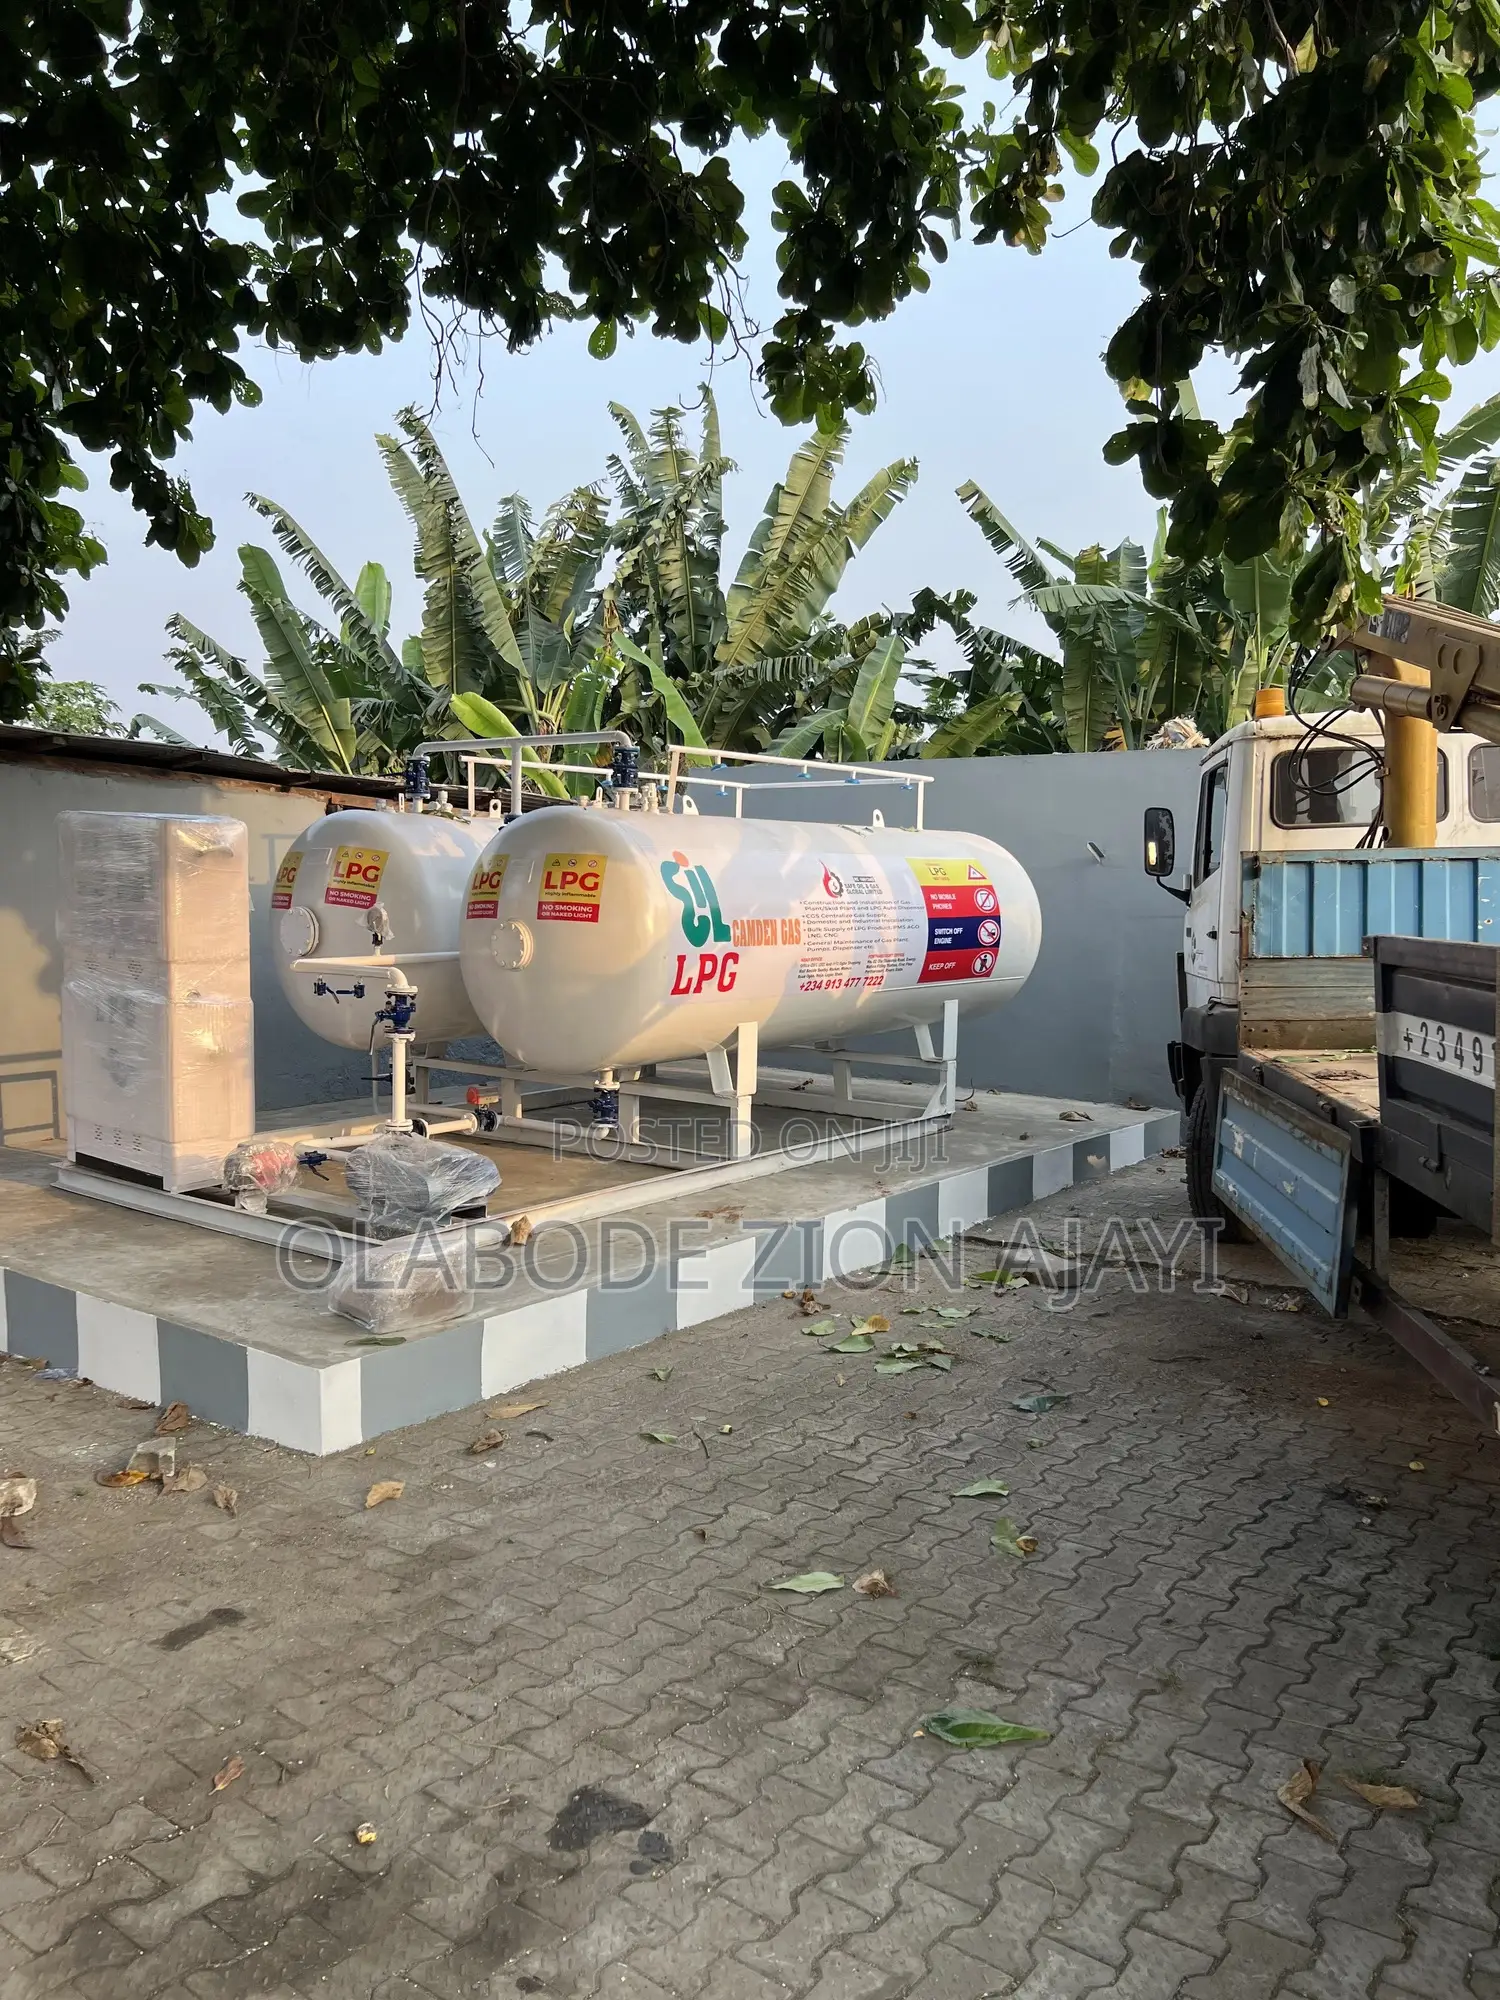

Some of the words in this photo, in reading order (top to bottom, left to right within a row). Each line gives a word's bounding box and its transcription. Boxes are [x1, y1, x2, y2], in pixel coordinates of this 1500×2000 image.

[334, 860, 381, 883] LPG
[928, 867, 947, 876] LPG
[472, 871, 502, 890] LPG
[544, 871, 600, 891] LPG
[340, 891, 372, 901] SMOKING
[554, 904, 593, 913] SMOKING
[732, 919, 778, 947] CAMDEN
[780, 918, 802, 945] GAS
[934, 927, 954, 935] SWITCH
[953, 927, 964, 935] OFF
[934, 937, 953, 945] ENGINE
[670, 952, 740, 996] LPG
[928, 962, 945, 971] KEEP
[944, 961, 957, 970] OFF
[799, 979, 824, 991] +234
[824, 978, 843, 990] 913
[843, 977, 862, 988] 477
[862, 975, 884, 987] 7222
[1403, 1021, 1496, 1081] +2349
